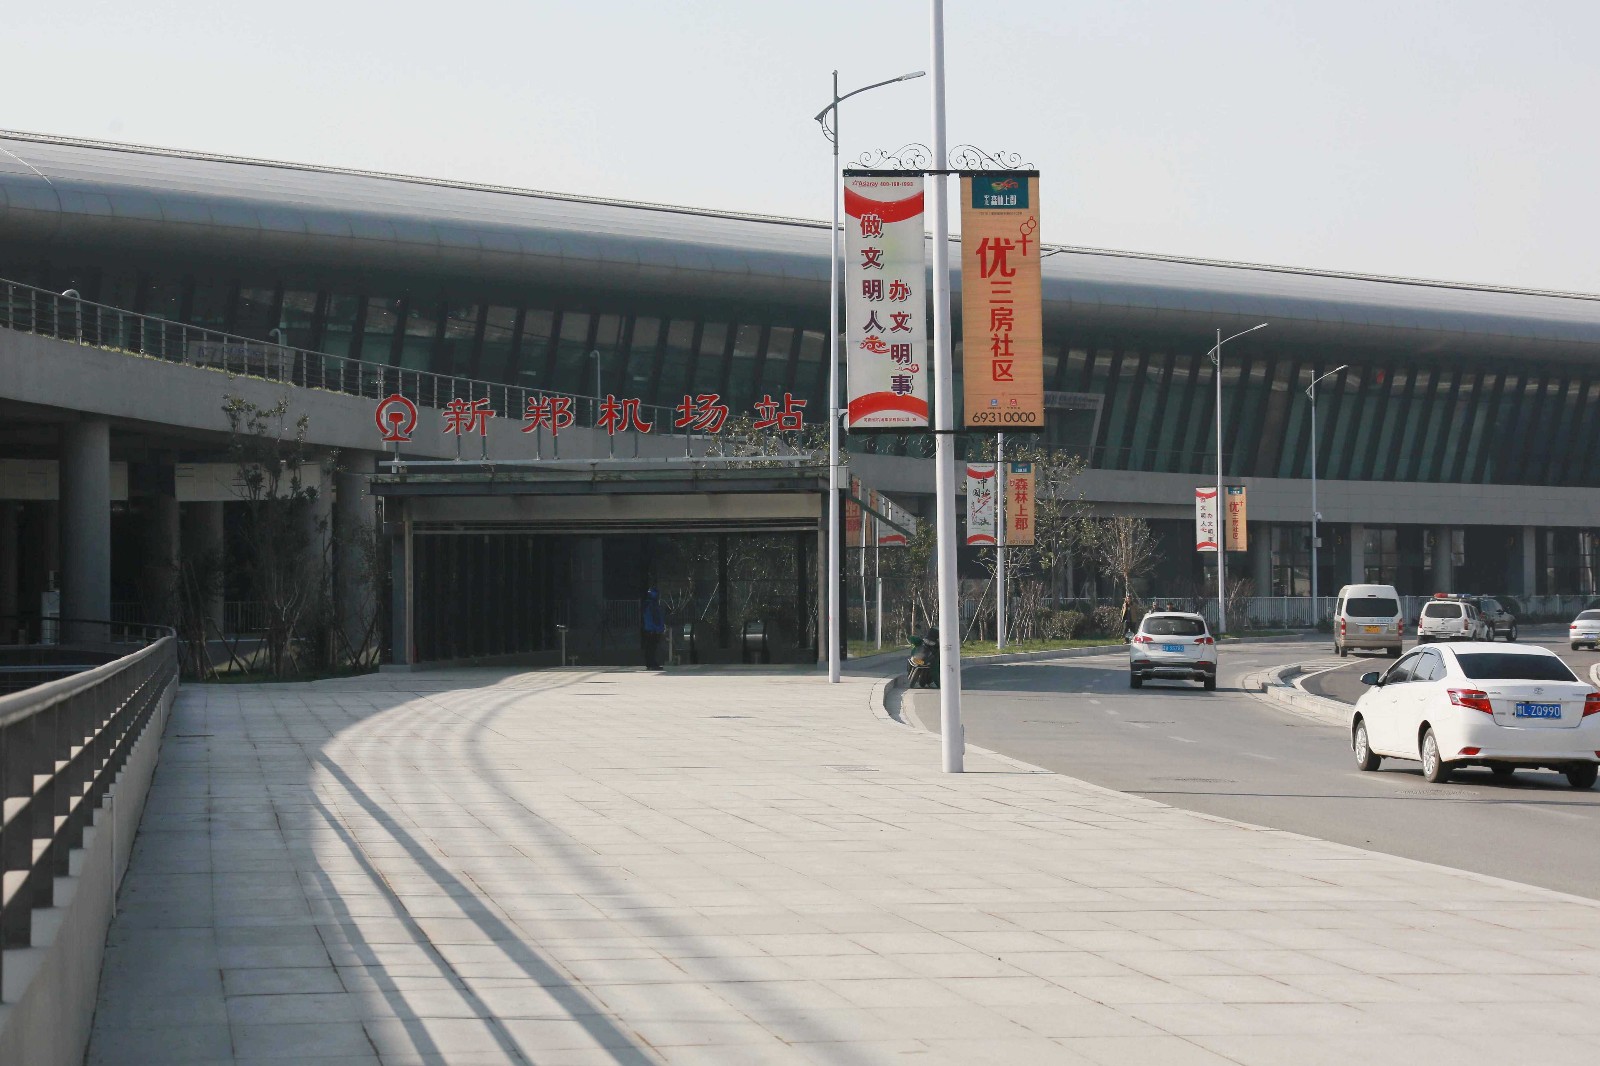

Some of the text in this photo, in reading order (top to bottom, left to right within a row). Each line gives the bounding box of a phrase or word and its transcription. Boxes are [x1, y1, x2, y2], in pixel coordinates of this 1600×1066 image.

[860, 214, 885, 333] 做文明人
[888, 279, 913, 396] 办文明事
[442, 392, 808, 437] 新郑机场站
[972, 411, 1036, 423] 69310000
[1015, 478, 1028, 530] 森林上郡
